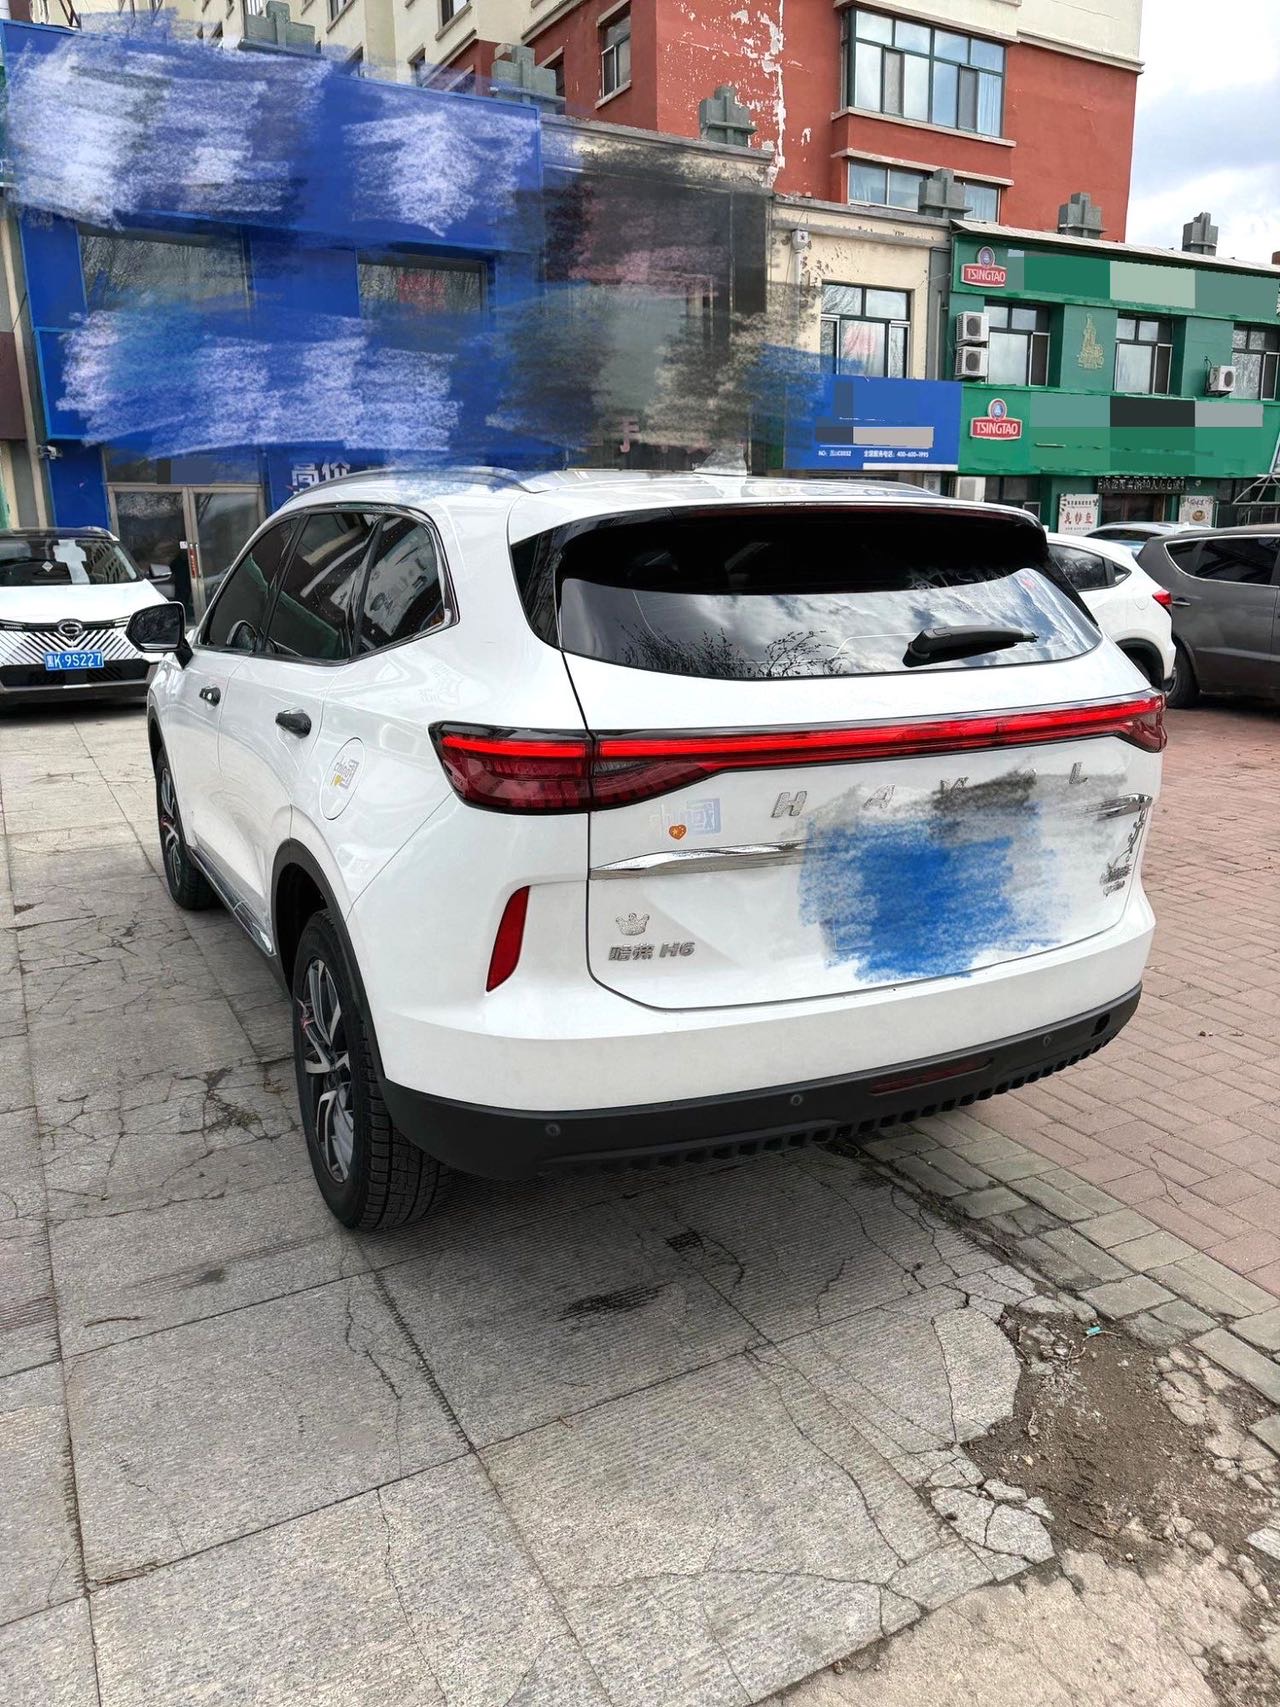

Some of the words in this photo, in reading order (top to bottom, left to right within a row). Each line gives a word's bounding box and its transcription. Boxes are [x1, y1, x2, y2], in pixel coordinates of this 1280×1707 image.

[966, 268, 1006, 282] TSINGTAO
[975, 422, 1019, 435] TSINGTAO
[659, 942, 695, 958] H6
